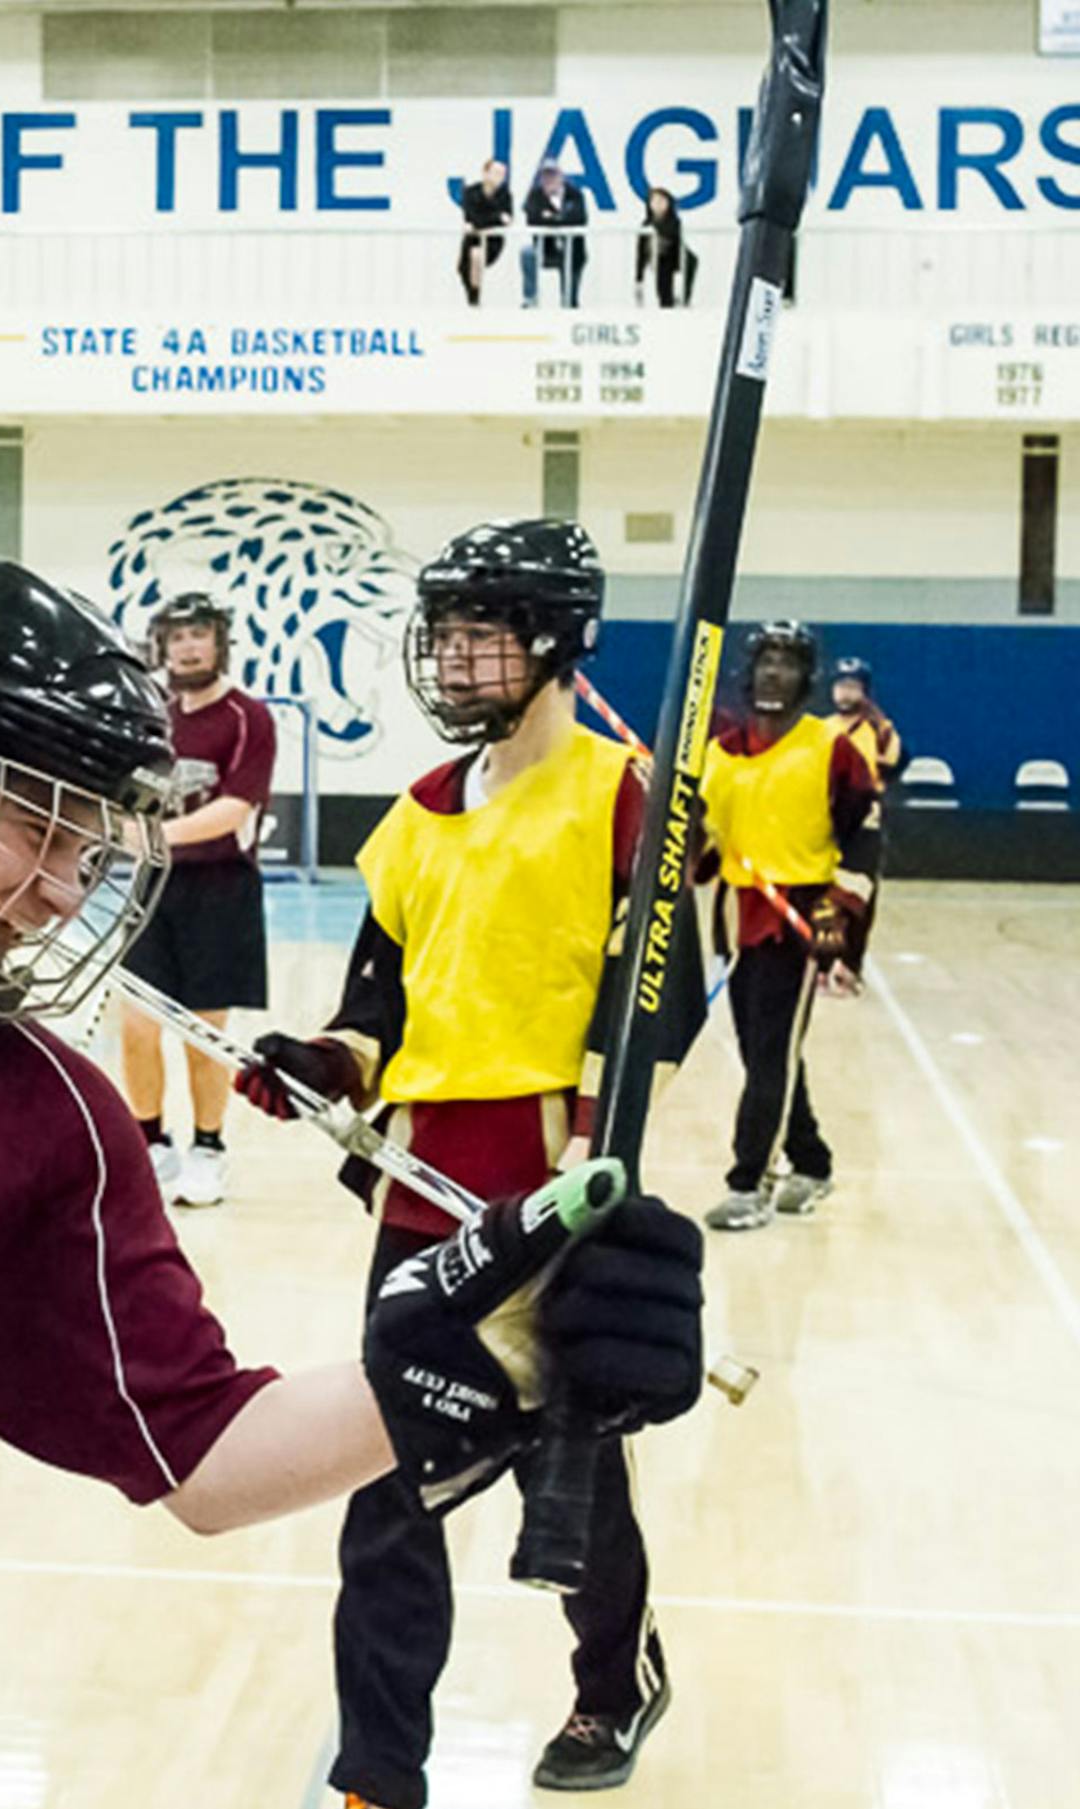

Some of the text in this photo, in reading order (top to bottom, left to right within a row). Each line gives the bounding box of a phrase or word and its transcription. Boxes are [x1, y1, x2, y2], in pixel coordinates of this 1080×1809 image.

[129, 109, 392, 213] THE
[41, 327, 425, 357] STATE 4A BASKETBALL
[571, 322, 641, 346] GIRLS
[949, 323, 1013, 347] GIRLS
[131, 365, 326, 394] CHAMPIONS
[637, 773, 695, 1014] ULTRA SHAFT
